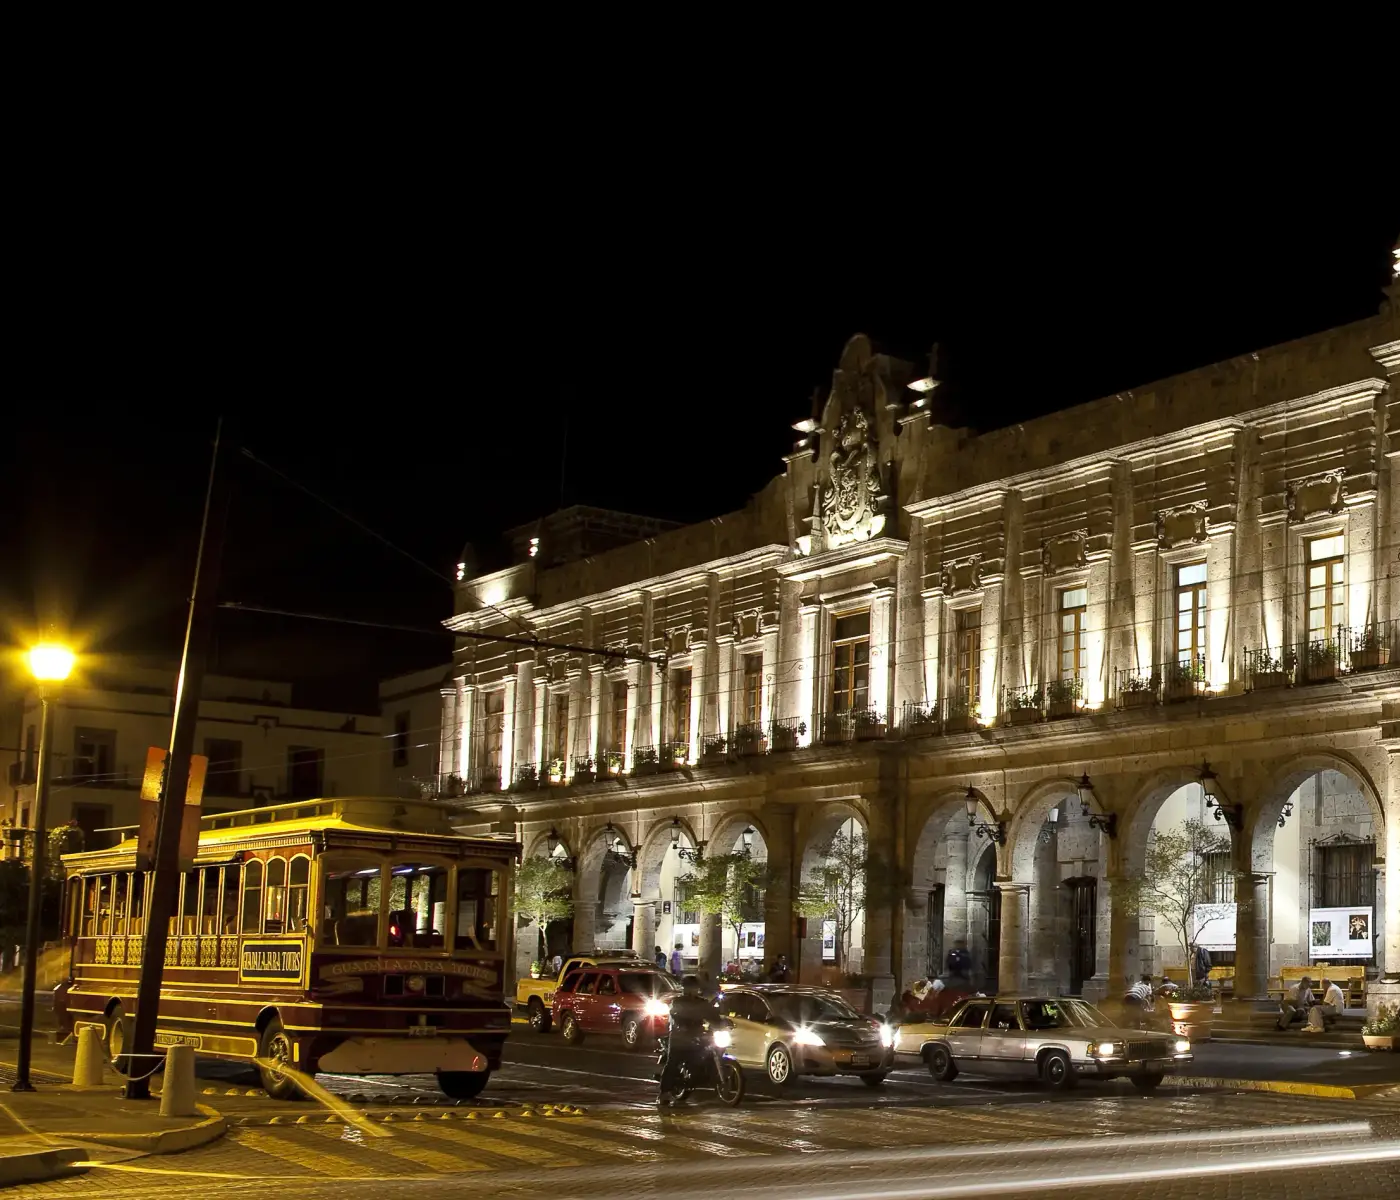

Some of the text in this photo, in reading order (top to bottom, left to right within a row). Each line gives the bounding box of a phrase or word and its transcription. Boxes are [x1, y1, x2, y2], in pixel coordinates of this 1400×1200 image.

[281, 951, 301, 972] TOURS
[332, 960, 489, 980] GUADALAJARA TOURS
